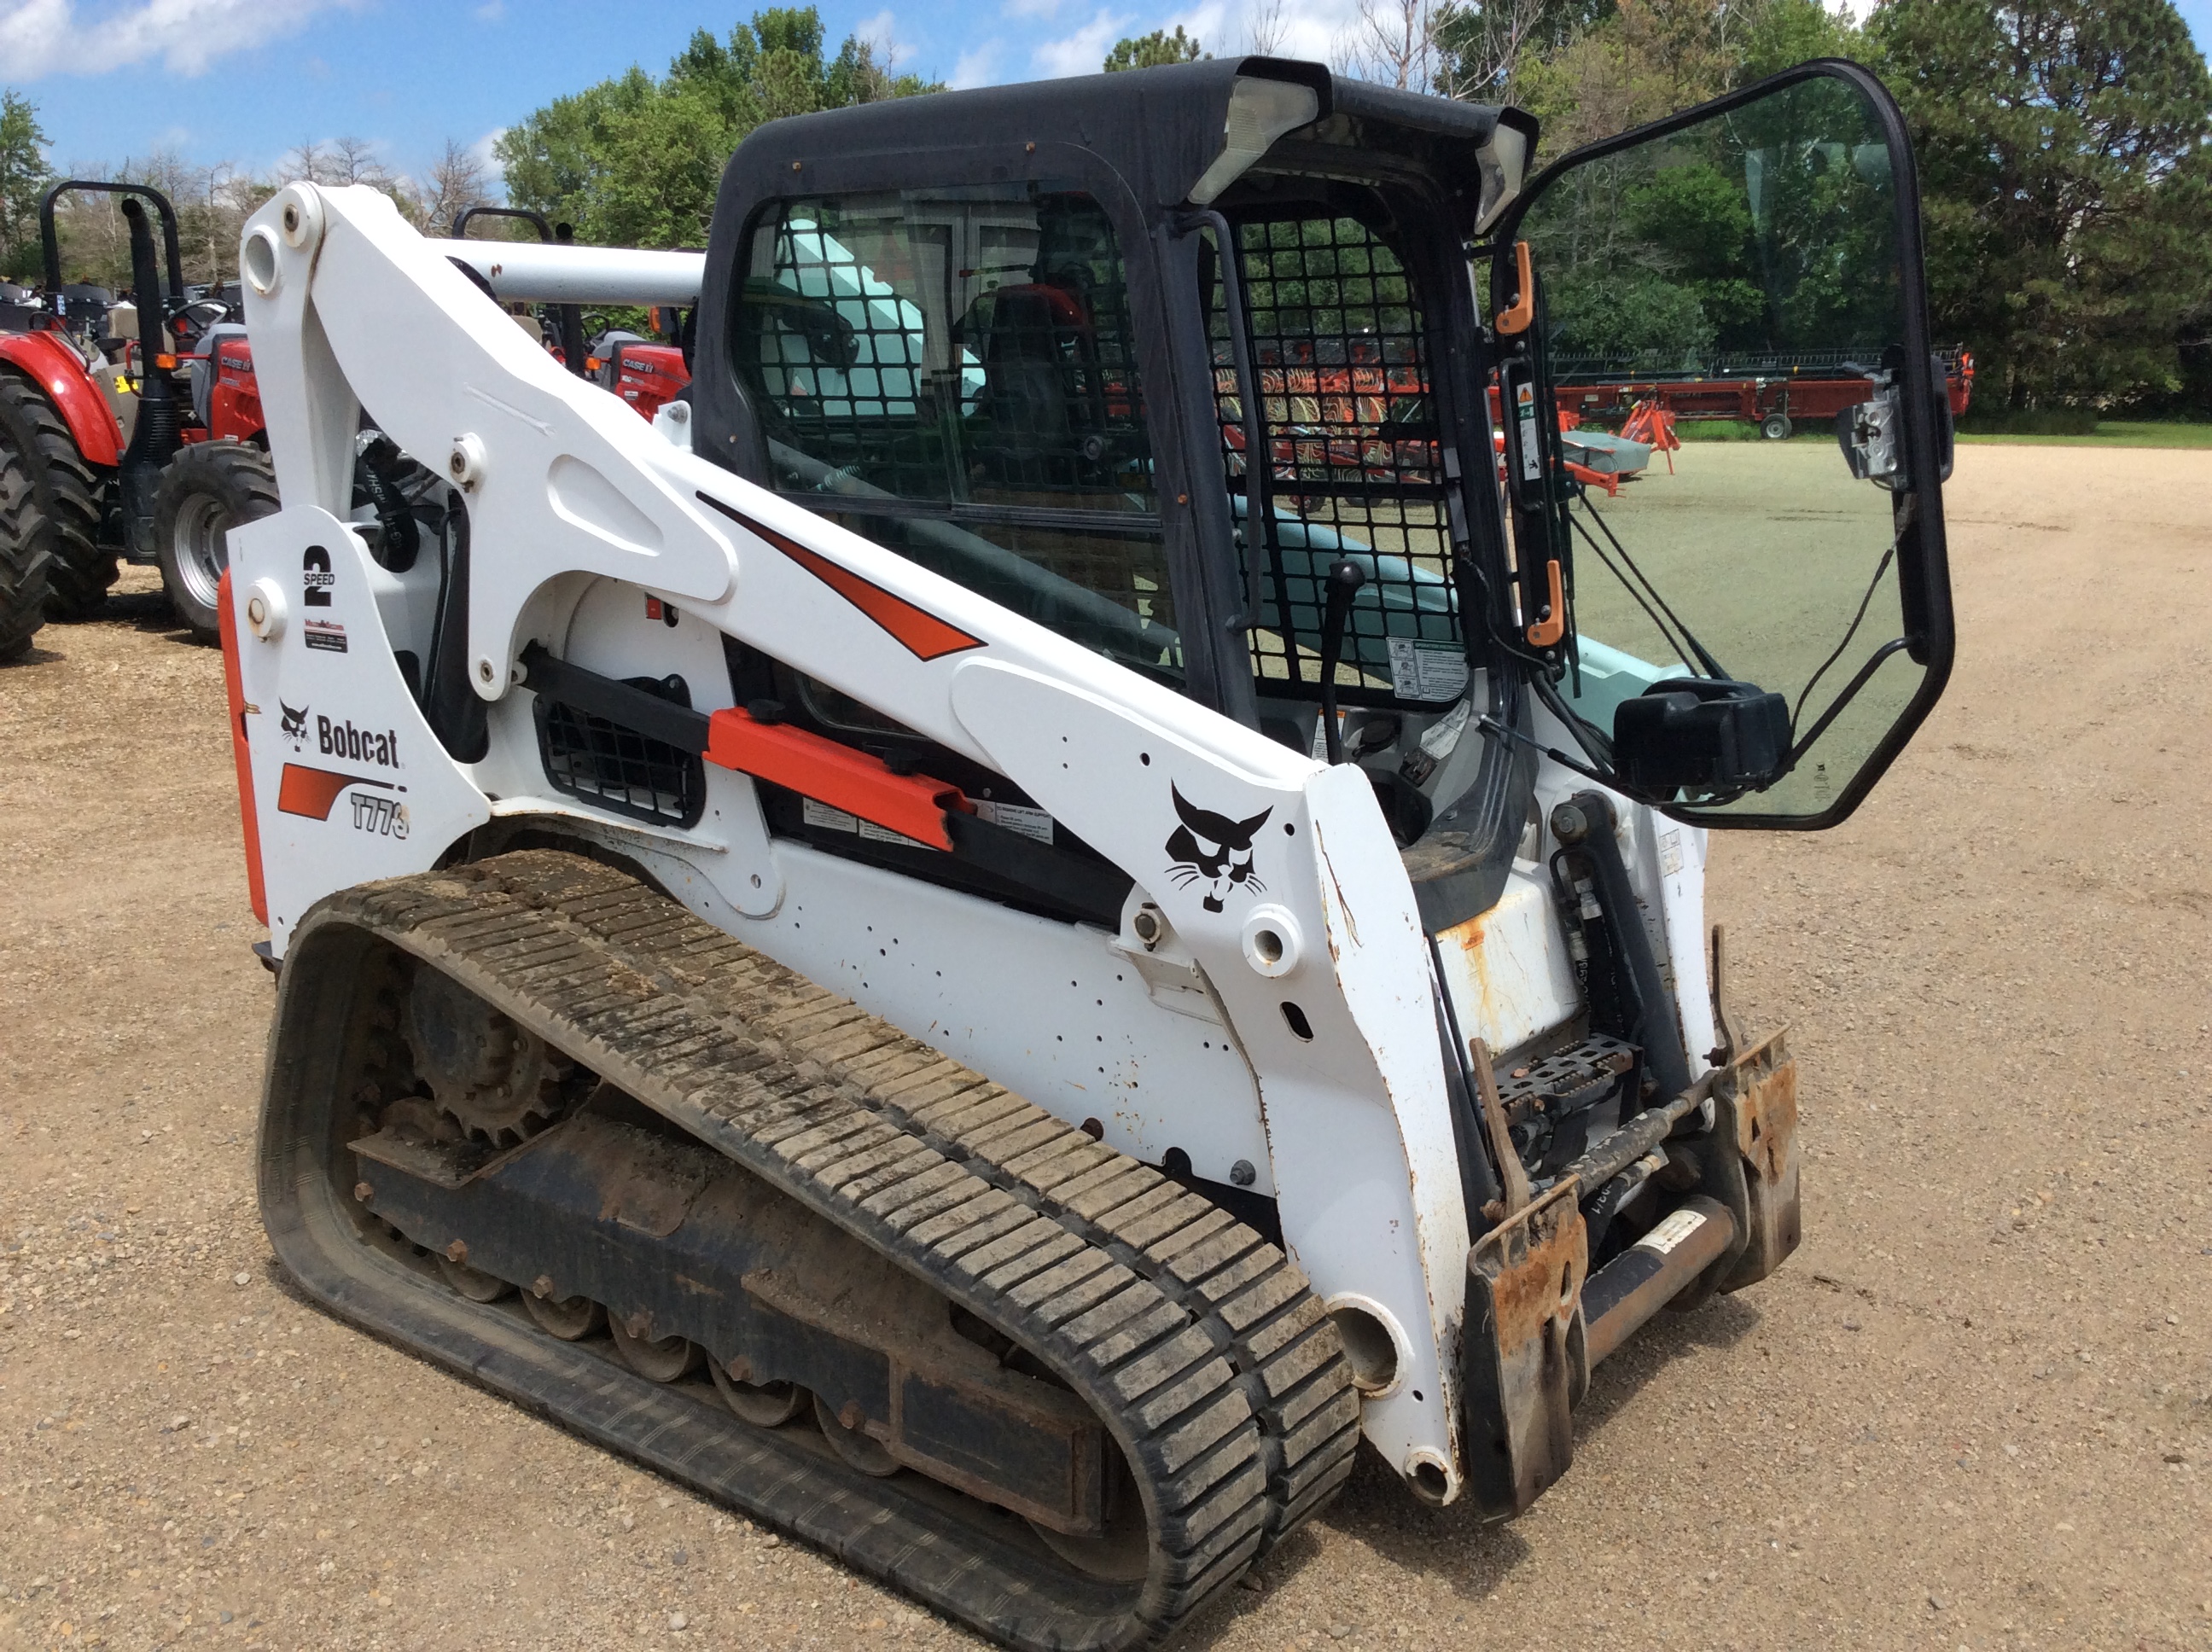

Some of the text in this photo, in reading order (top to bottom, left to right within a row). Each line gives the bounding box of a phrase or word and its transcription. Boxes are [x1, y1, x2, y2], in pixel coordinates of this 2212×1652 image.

[623, 358, 645, 371] CASE
[304, 573, 335, 586] SPEED
[317, 714, 399, 769] Bobcat
